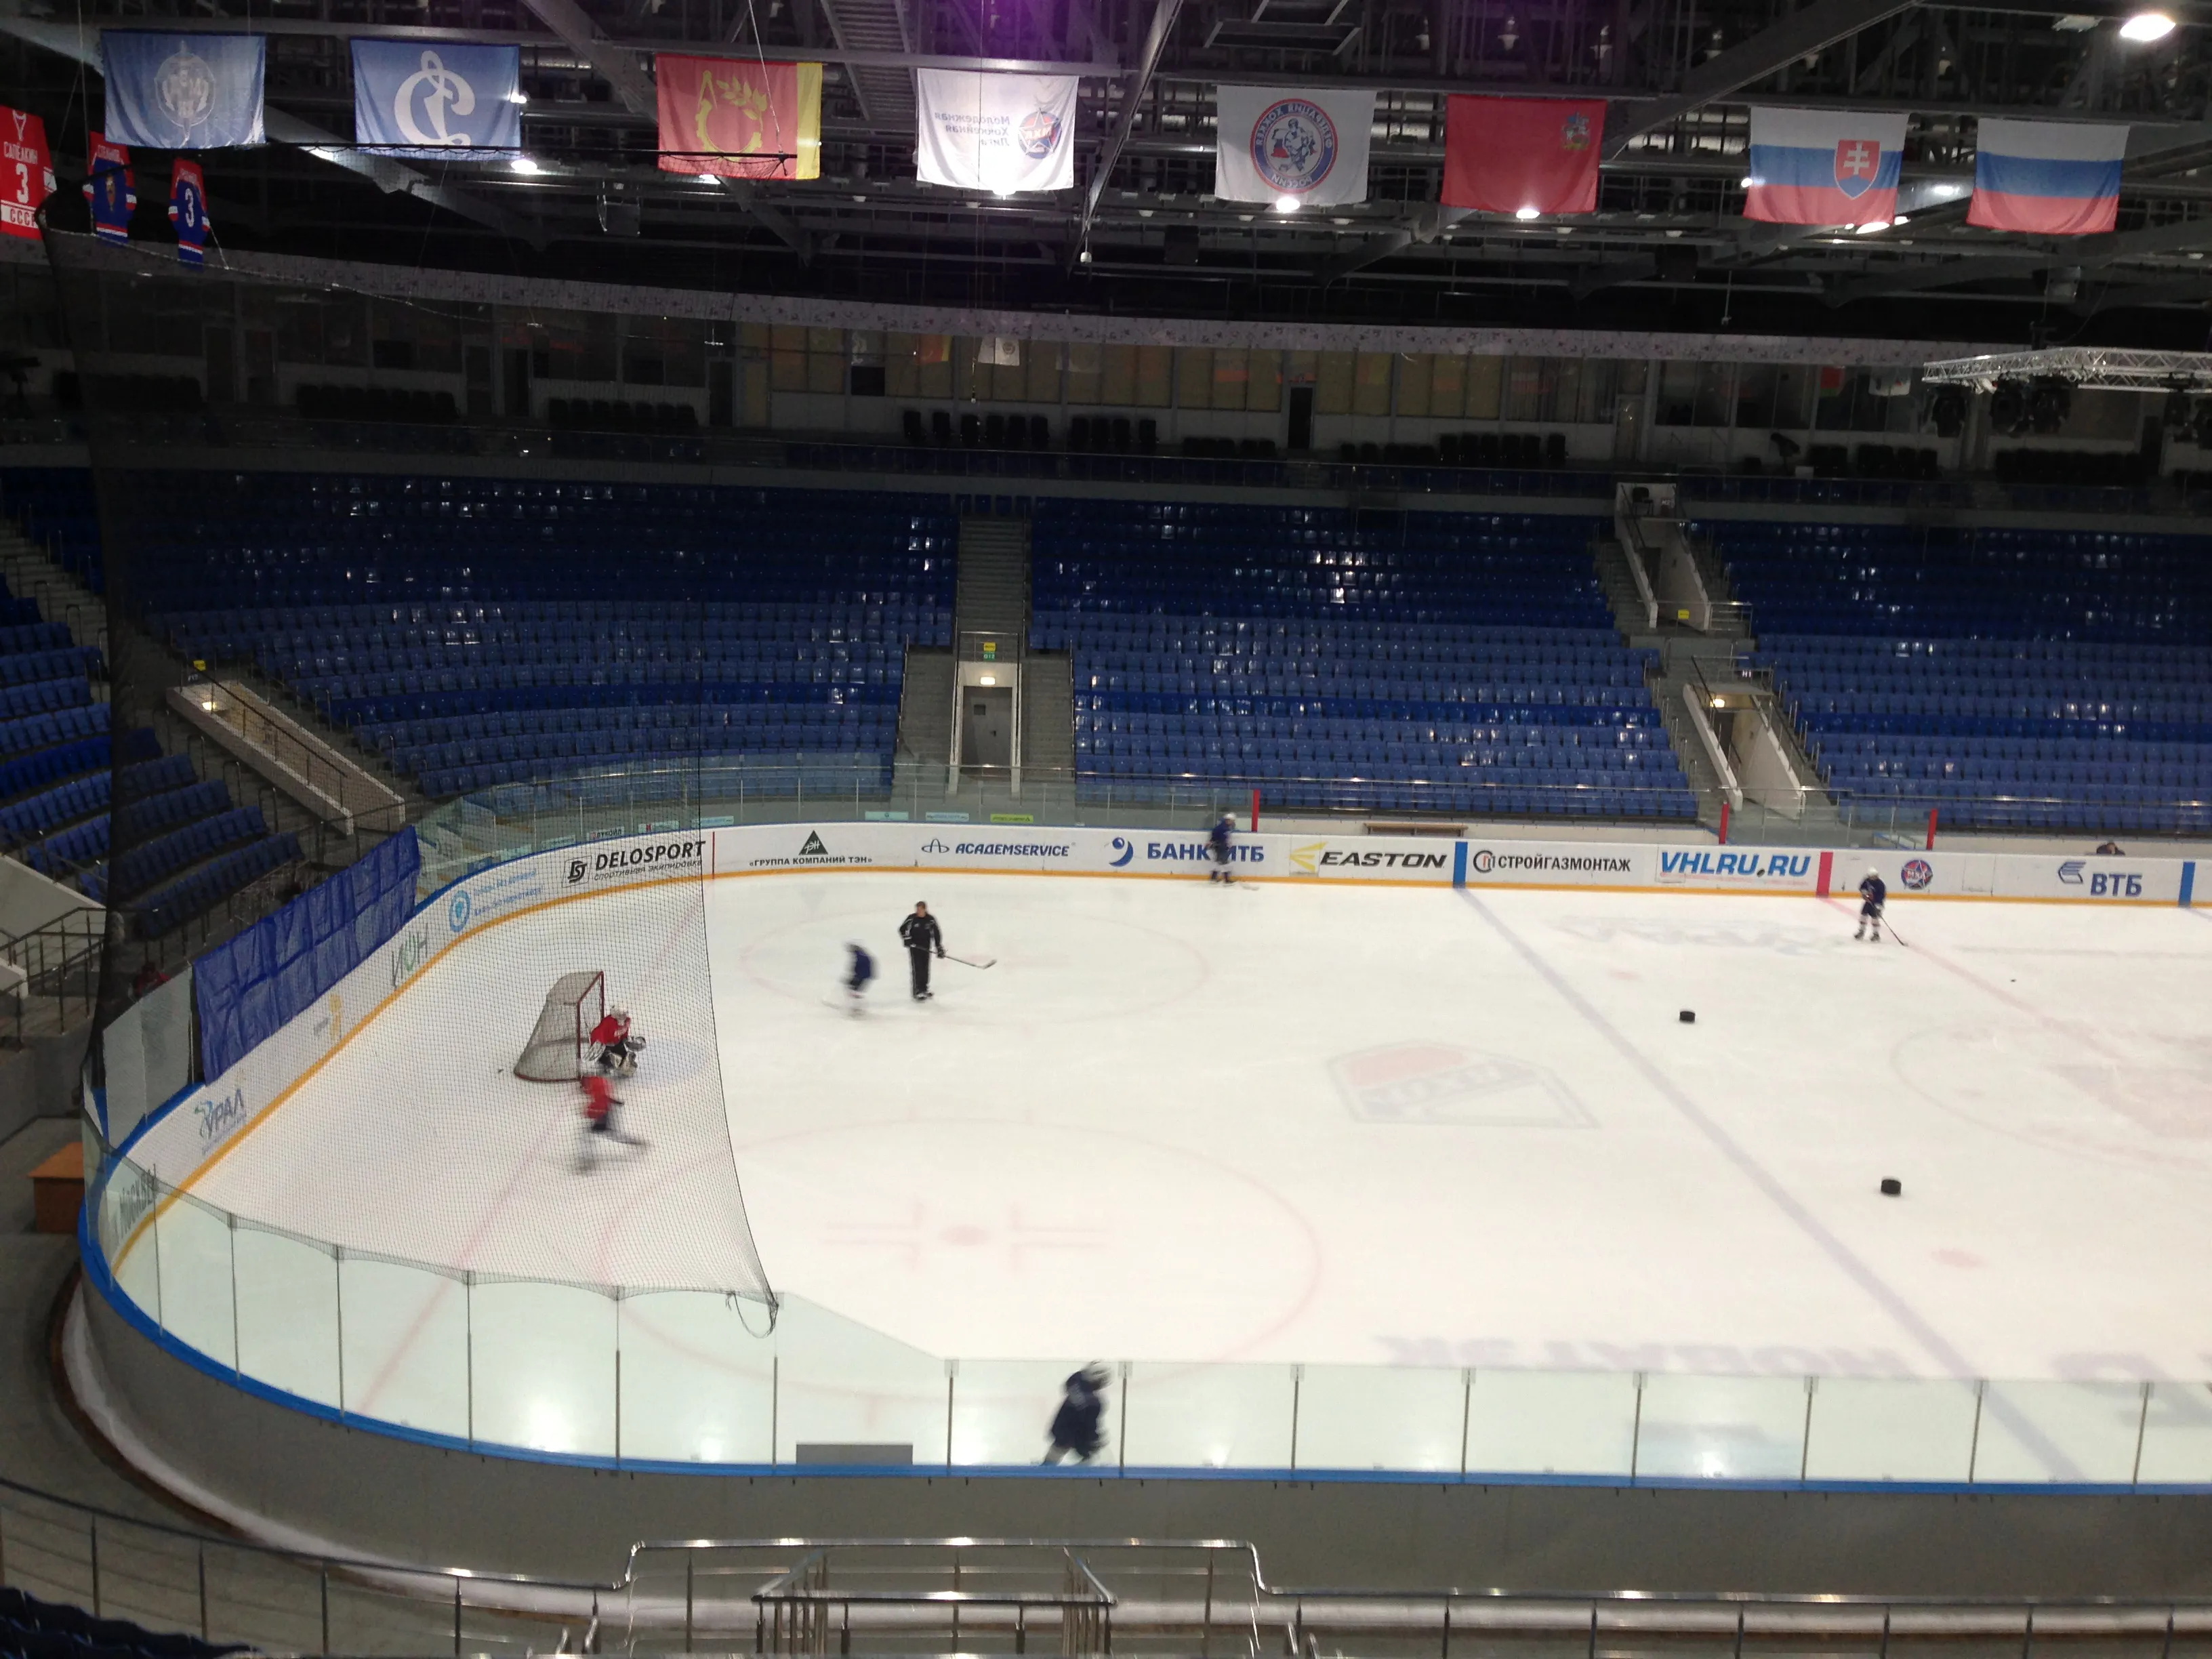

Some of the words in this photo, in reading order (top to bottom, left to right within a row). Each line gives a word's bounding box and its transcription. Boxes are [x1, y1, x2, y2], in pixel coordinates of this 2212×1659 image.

[16, 163, 29, 203] 3
[184, 188, 194, 228] 3
[596, 841, 706, 872] DELOSPORT
[792, 856, 846, 865] КОМПАНИЙ
[1147, 842, 1211, 861] БАНК
[1319, 851, 1448, 869] EASTON
[1498, 853, 1631, 872] СТРОЙГАЗМОНТАЖ
[1661, 851, 1811, 878] VHLRU.RU
[2090, 873, 2143, 898] ВТБ
